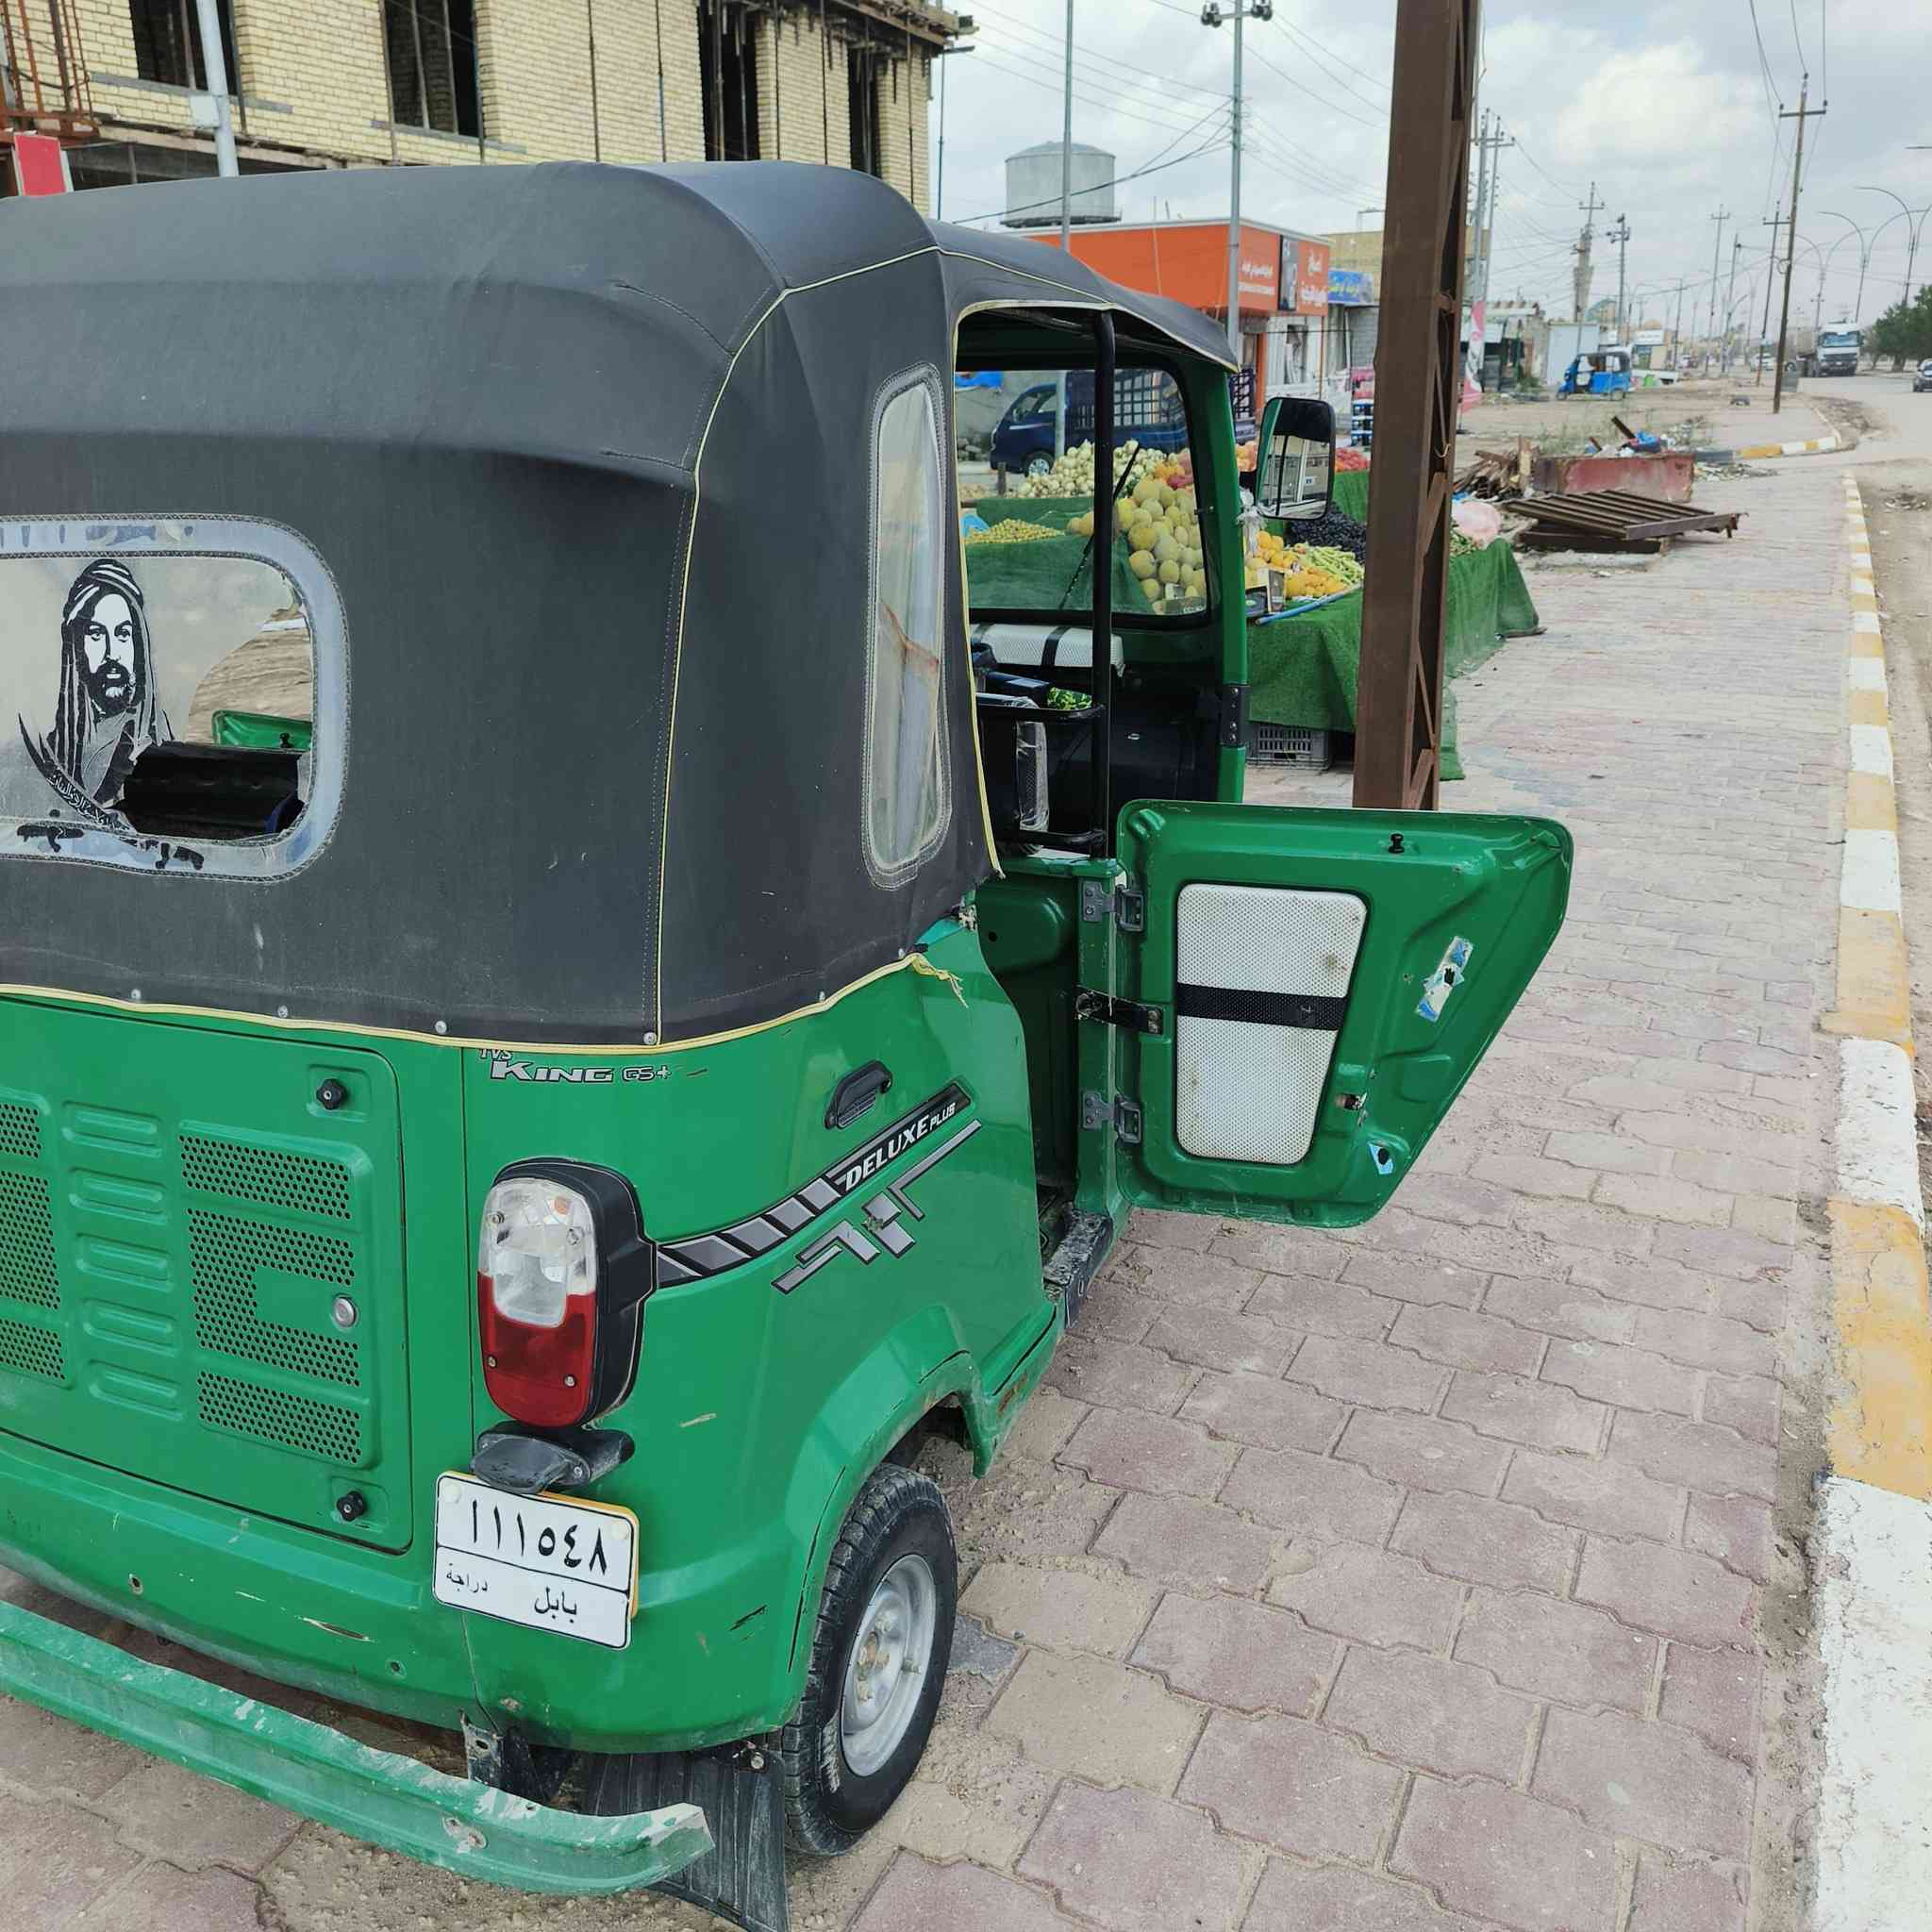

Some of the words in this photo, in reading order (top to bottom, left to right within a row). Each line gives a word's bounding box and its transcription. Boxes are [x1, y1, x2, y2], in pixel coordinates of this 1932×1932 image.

[491, 1060, 613, 1083] KING
[622, 1065, 673, 1081] GS+
[844, 1114, 930, 1191] DELUXE
[929, 1102, 957, 1131] PLUS
[472, 1500, 608, 1575] ١١١٥٤٨
[534, 1587, 578, 1624] بابل
